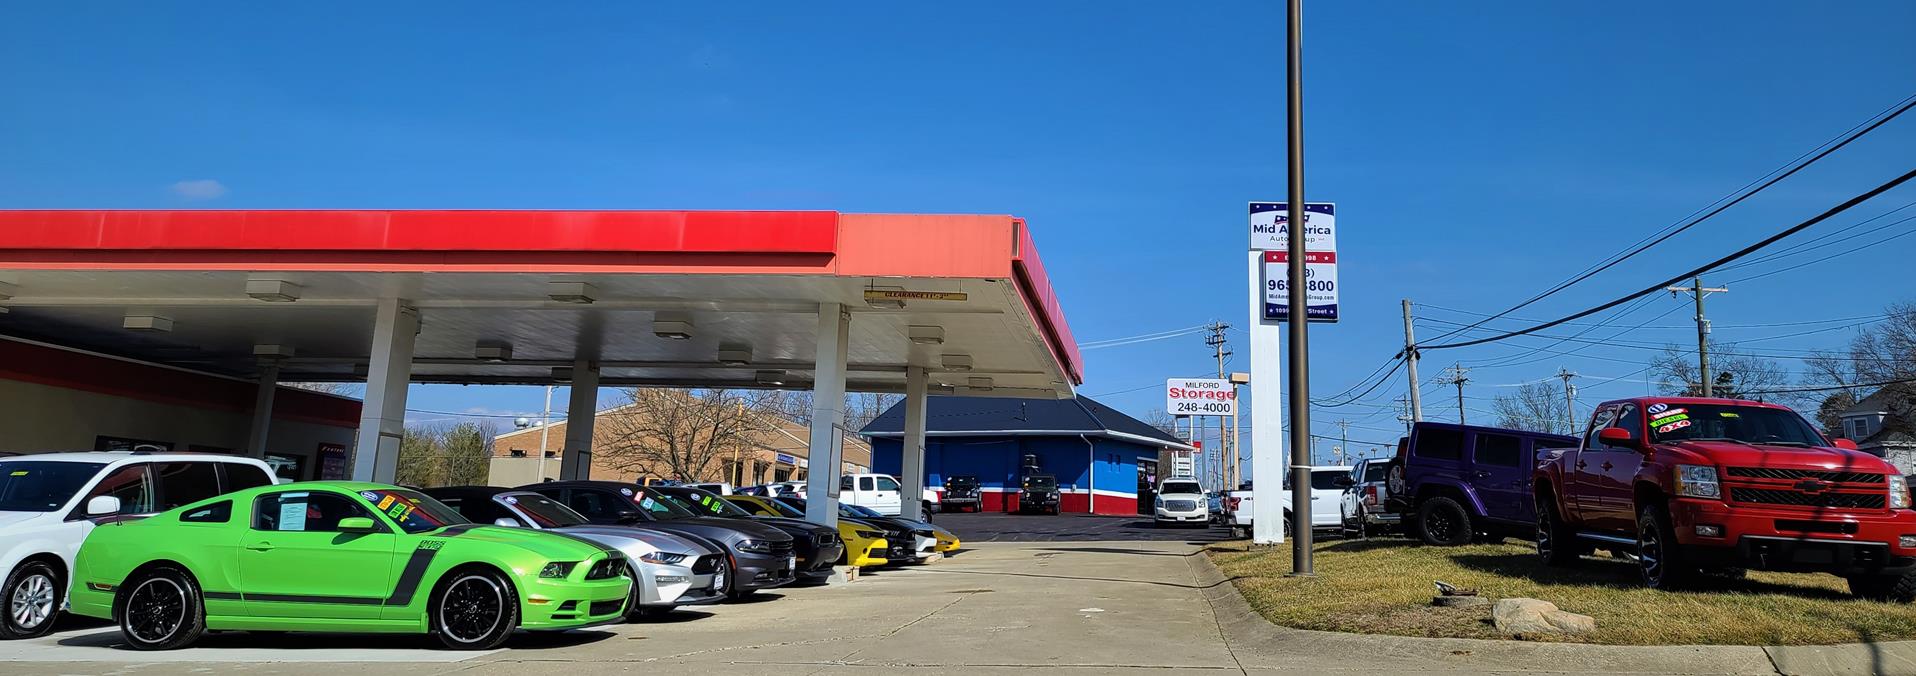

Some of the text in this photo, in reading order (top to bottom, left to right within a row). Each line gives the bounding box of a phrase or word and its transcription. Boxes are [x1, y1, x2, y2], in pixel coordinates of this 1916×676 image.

[1253, 224, 1331, 235] Mid Aerica
[1169, 387, 1236, 402] Storage
[1177, 402, 1231, 412] 248-4000
